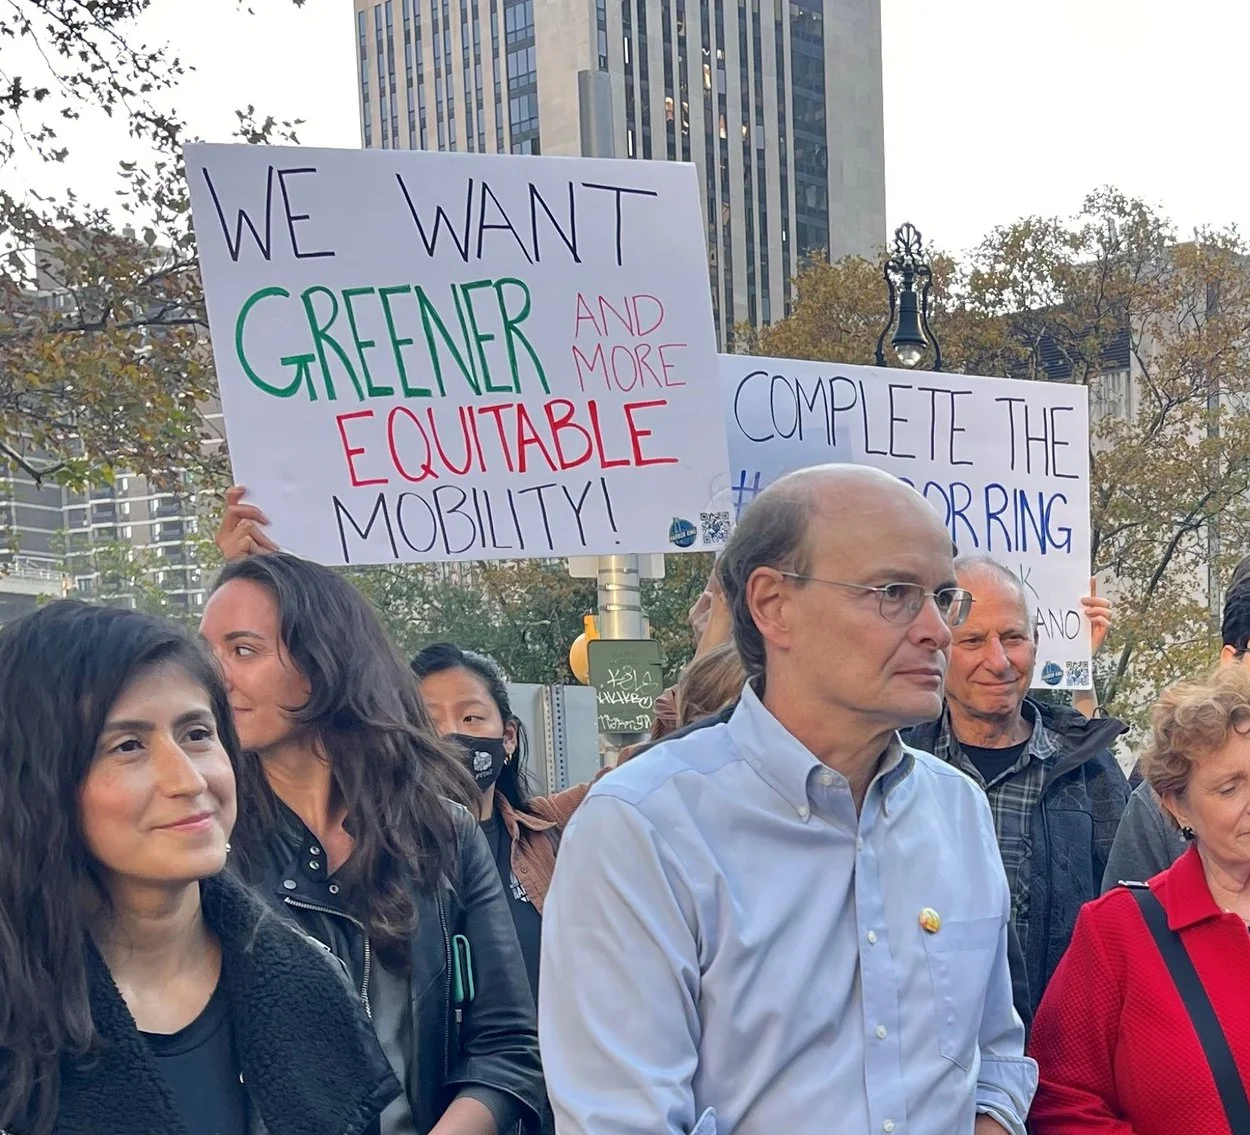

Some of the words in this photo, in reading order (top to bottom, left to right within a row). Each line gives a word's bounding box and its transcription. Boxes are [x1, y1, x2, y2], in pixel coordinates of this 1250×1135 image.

[201, 165, 336, 262] WE
[396, 173, 659, 267] WANT
[234, 277, 551, 402] GREENER
[573, 292, 665, 340] AND
[572, 342, 688, 392] MORE
[336, 399, 679, 488] EQUITABLE
[733, 370, 974, 466] COMPLETE
[994, 397, 1080, 479] THE
[332, 477, 622, 564] MOBILITY!
